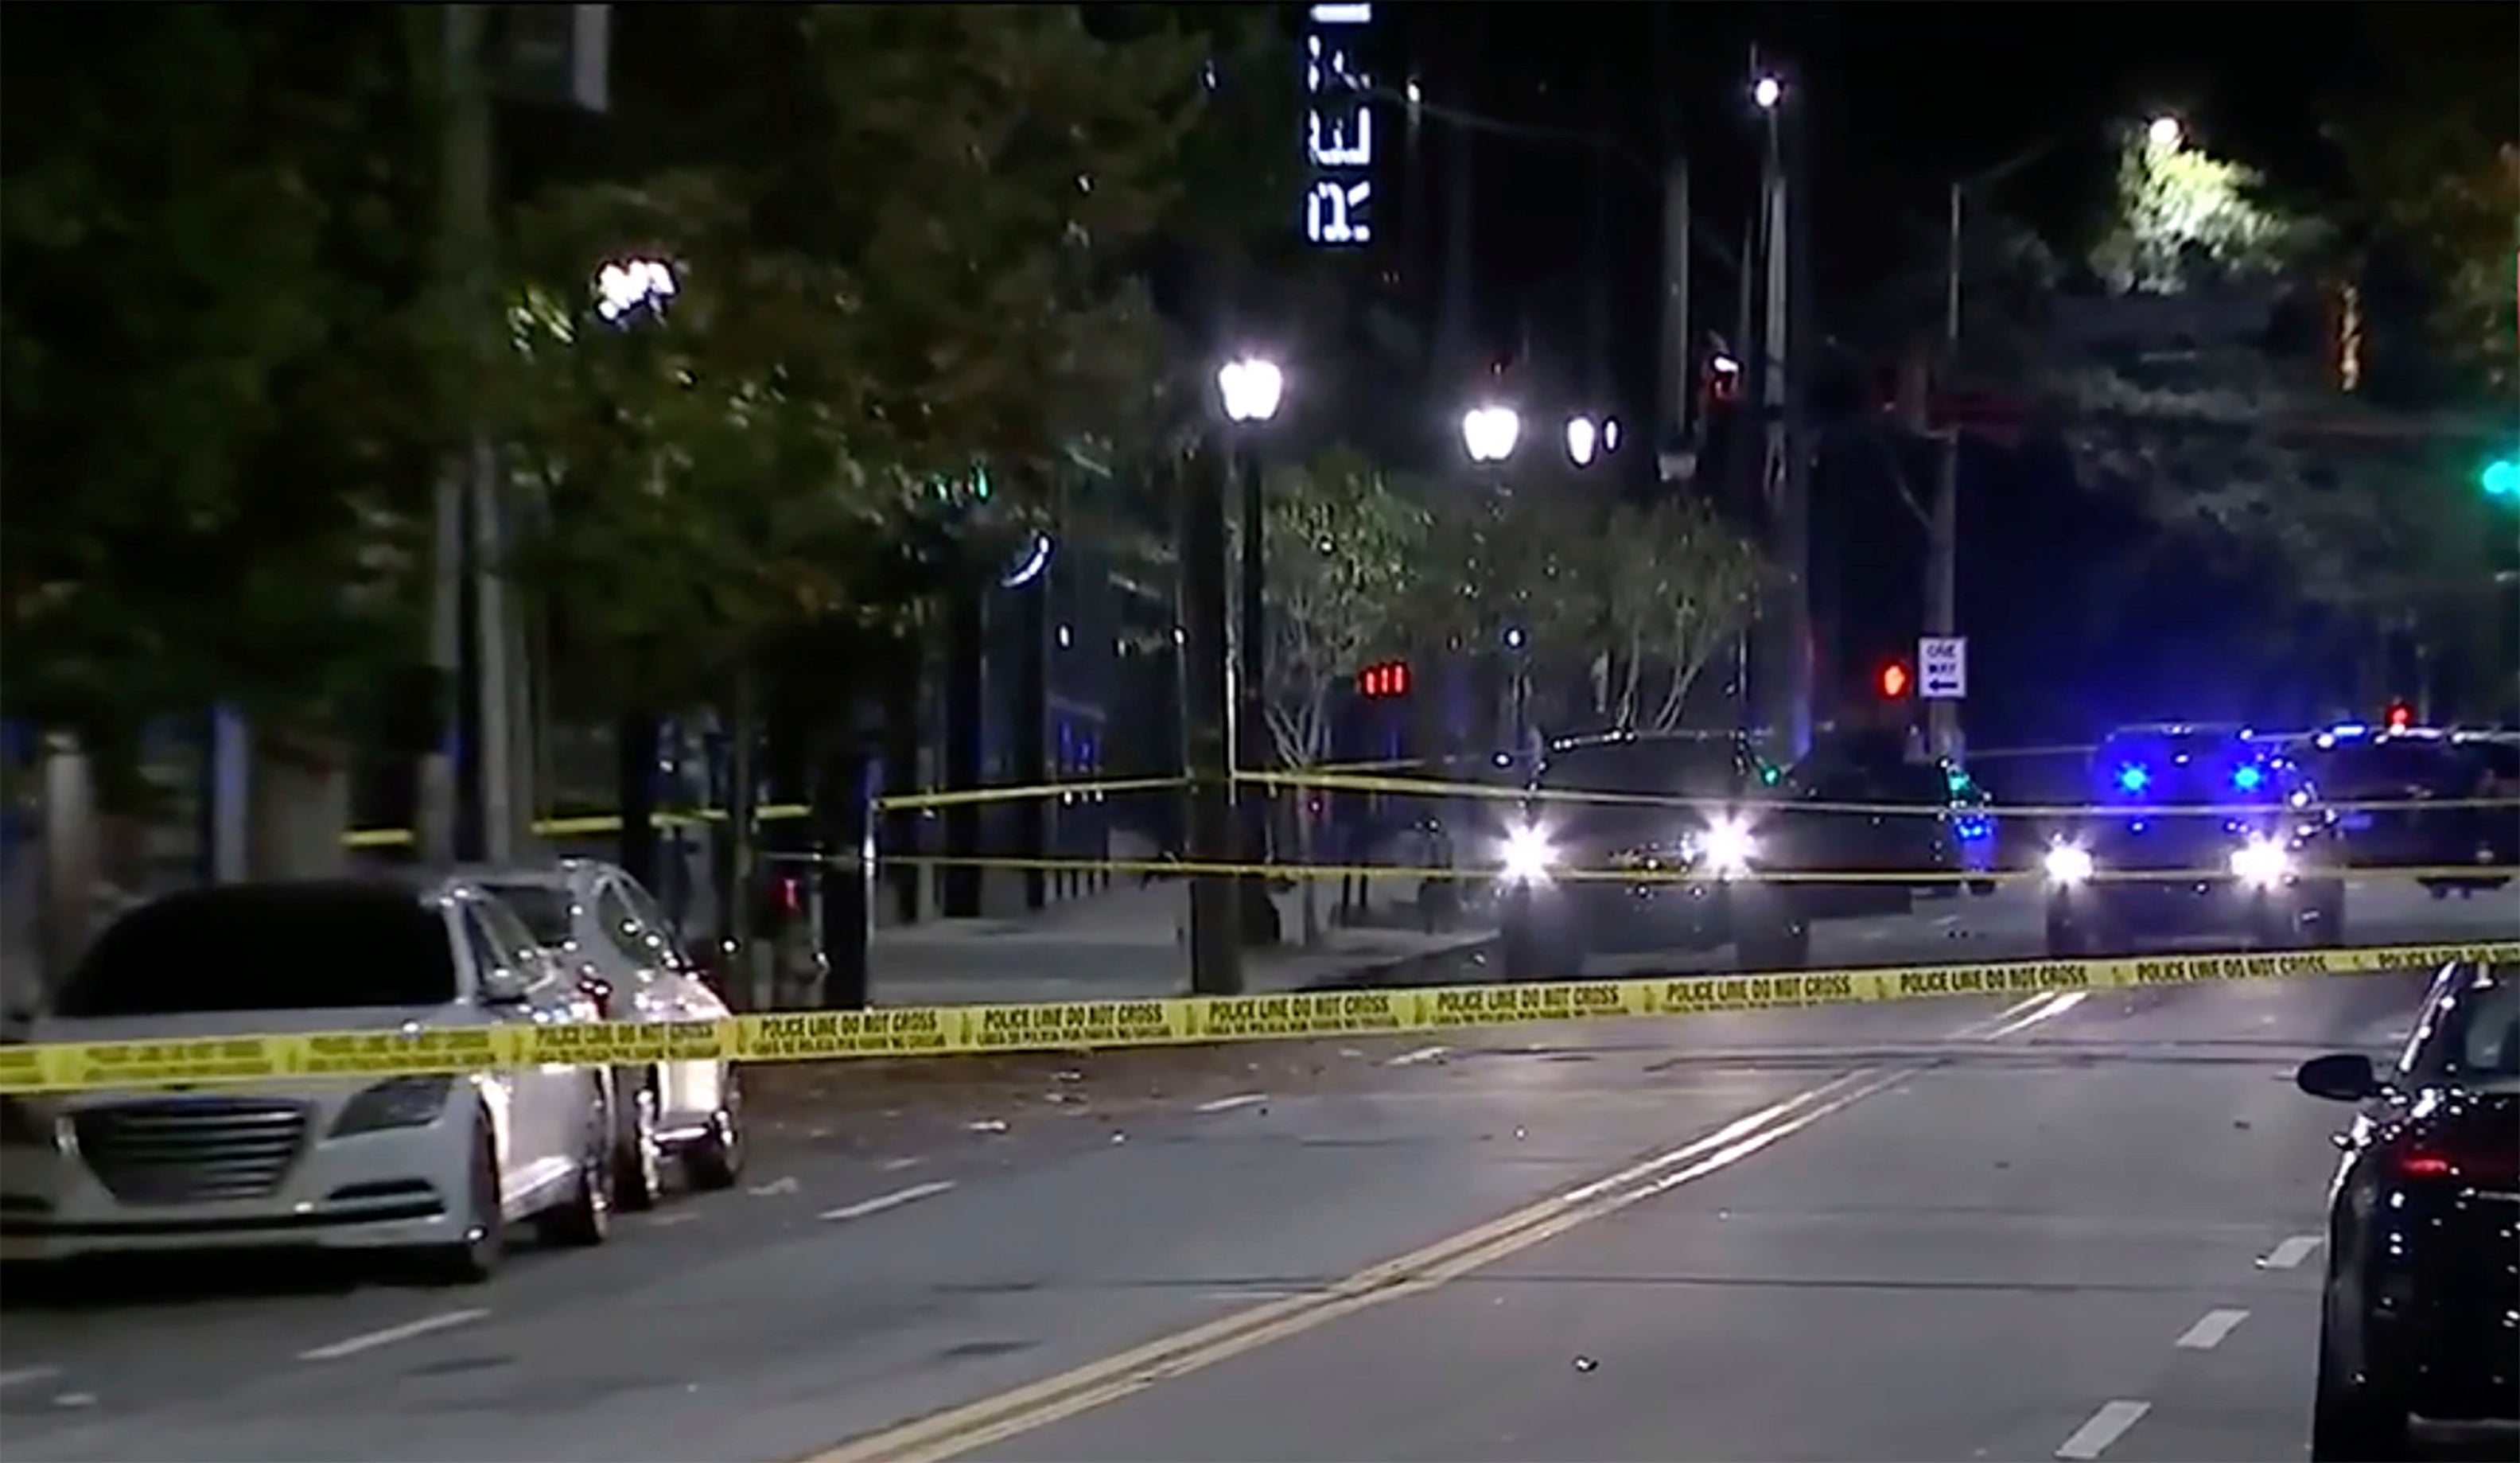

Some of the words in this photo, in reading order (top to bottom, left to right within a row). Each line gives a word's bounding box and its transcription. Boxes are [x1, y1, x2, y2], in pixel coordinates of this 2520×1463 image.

[1927, 644, 1957, 659] ONE
[1900, 972, 1948, 992] POLICE
[1951, 971, 1981, 991] LINE
[1986, 969, 2005, 989] DO
[2009, 967, 2036, 988] NOT
[2040, 965, 2087, 987] CROSS
[2137, 961, 2185, 982] POLICE
[2189, 960, 2219, 980] LINE
[2223, 958, 2246, 978] DO
[2248, 958, 2276, 977] NOT
[2279, 955, 2328, 976] CROSS
[1437, 990, 1484, 1011] POLICE
[1488, 989, 1517, 1010] LINE
[1521, 987, 1541, 1008] DO
[1545, 986, 1569, 1006] NOT
[1573, 984, 1619, 1006] CROSS
[1666, 982, 1713, 1002] POLICE
[1717, 980, 1748, 1000] LINE
[1752, 979, 1771, 999] DO
[1774, 978, 1801, 998] NOT
[1805, 976, 1851, 997] CROSS
[983, 1009, 1029, 1029] POLICE
[1033, 1007, 1062, 1027] LINE
[1066, 1006, 1084, 1025] DO
[1090, 1006, 1114, 1025] NOT
[1118, 1004, 1162, 1023] CROSS
[1209, 1001, 1255, 1021] POLICE
[1259, 999, 1289, 1019] LINE
[1292, 998, 1311, 1017] DO
[1315, 997, 1342, 1016] NOT
[1345, 994, 1389, 1015] CROSS
[761, 1017, 804, 1037] POLICE
[807, 1016, 836, 1036] LINE
[841, 1014, 860, 1033] DO
[864, 1014, 889, 1032] NOT
[892, 1012, 936, 1031] CROSS
